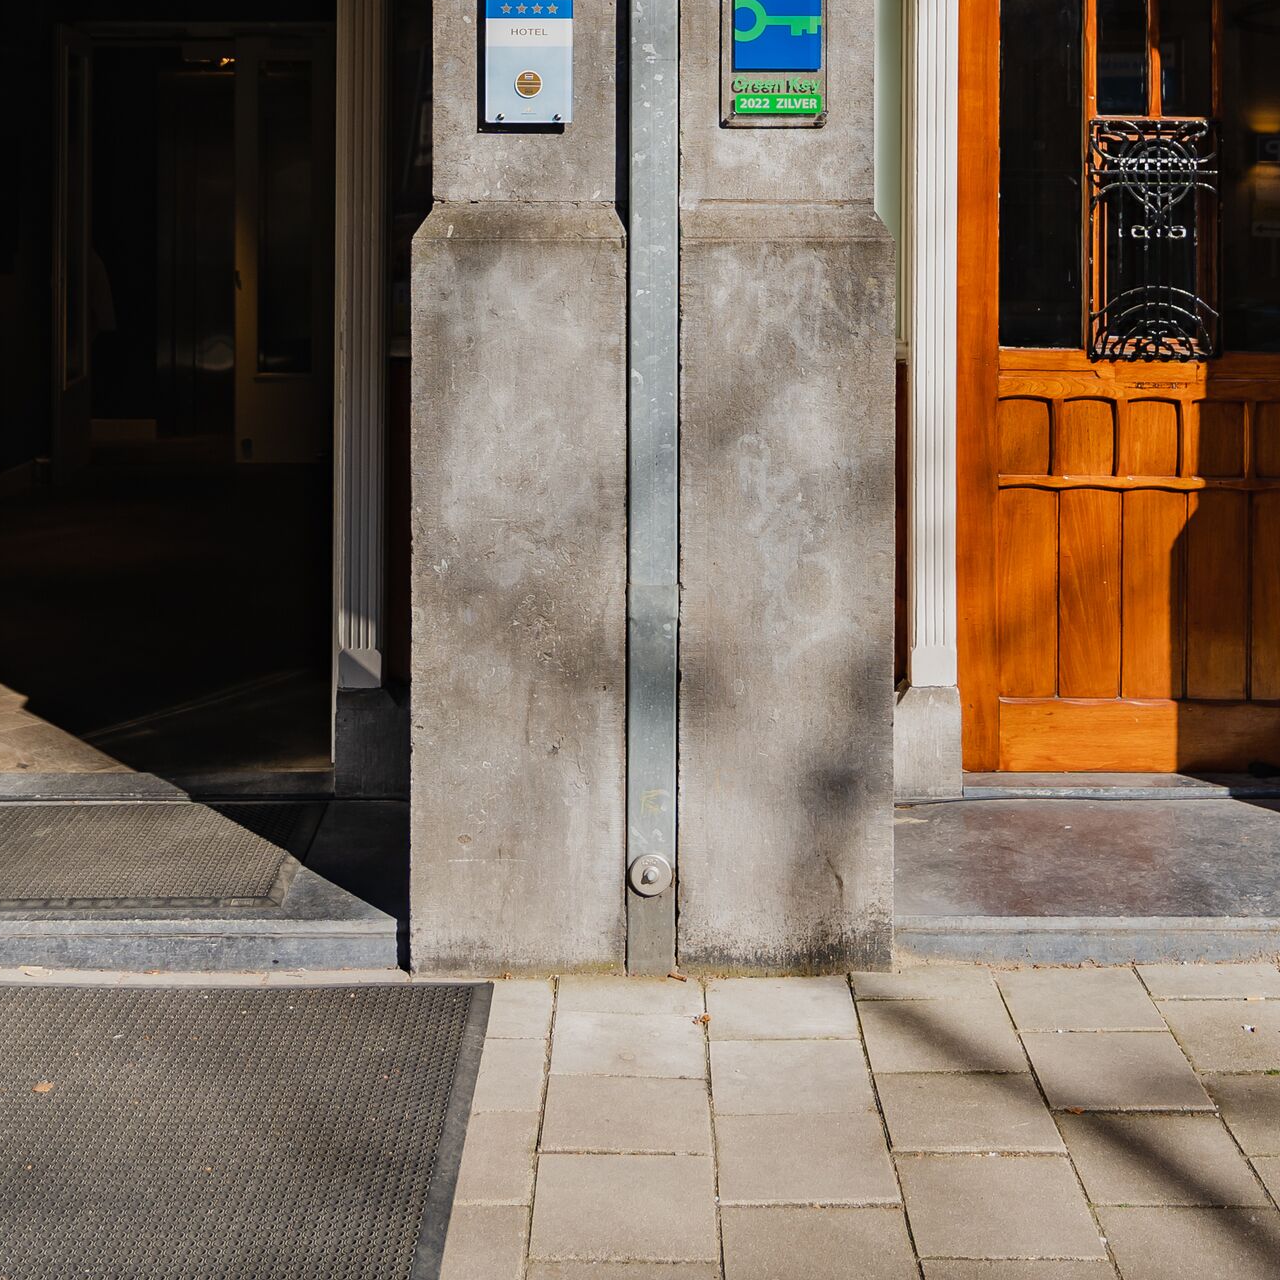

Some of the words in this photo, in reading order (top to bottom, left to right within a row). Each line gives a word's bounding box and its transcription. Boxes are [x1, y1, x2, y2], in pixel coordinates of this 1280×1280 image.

[510, 28, 549, 36] HOTEL
[733, 76, 785, 91] Green
[789, 76, 822, 94] Key
[739, 98, 770, 109] 2022
[776, 98, 818, 109] ZILVER
